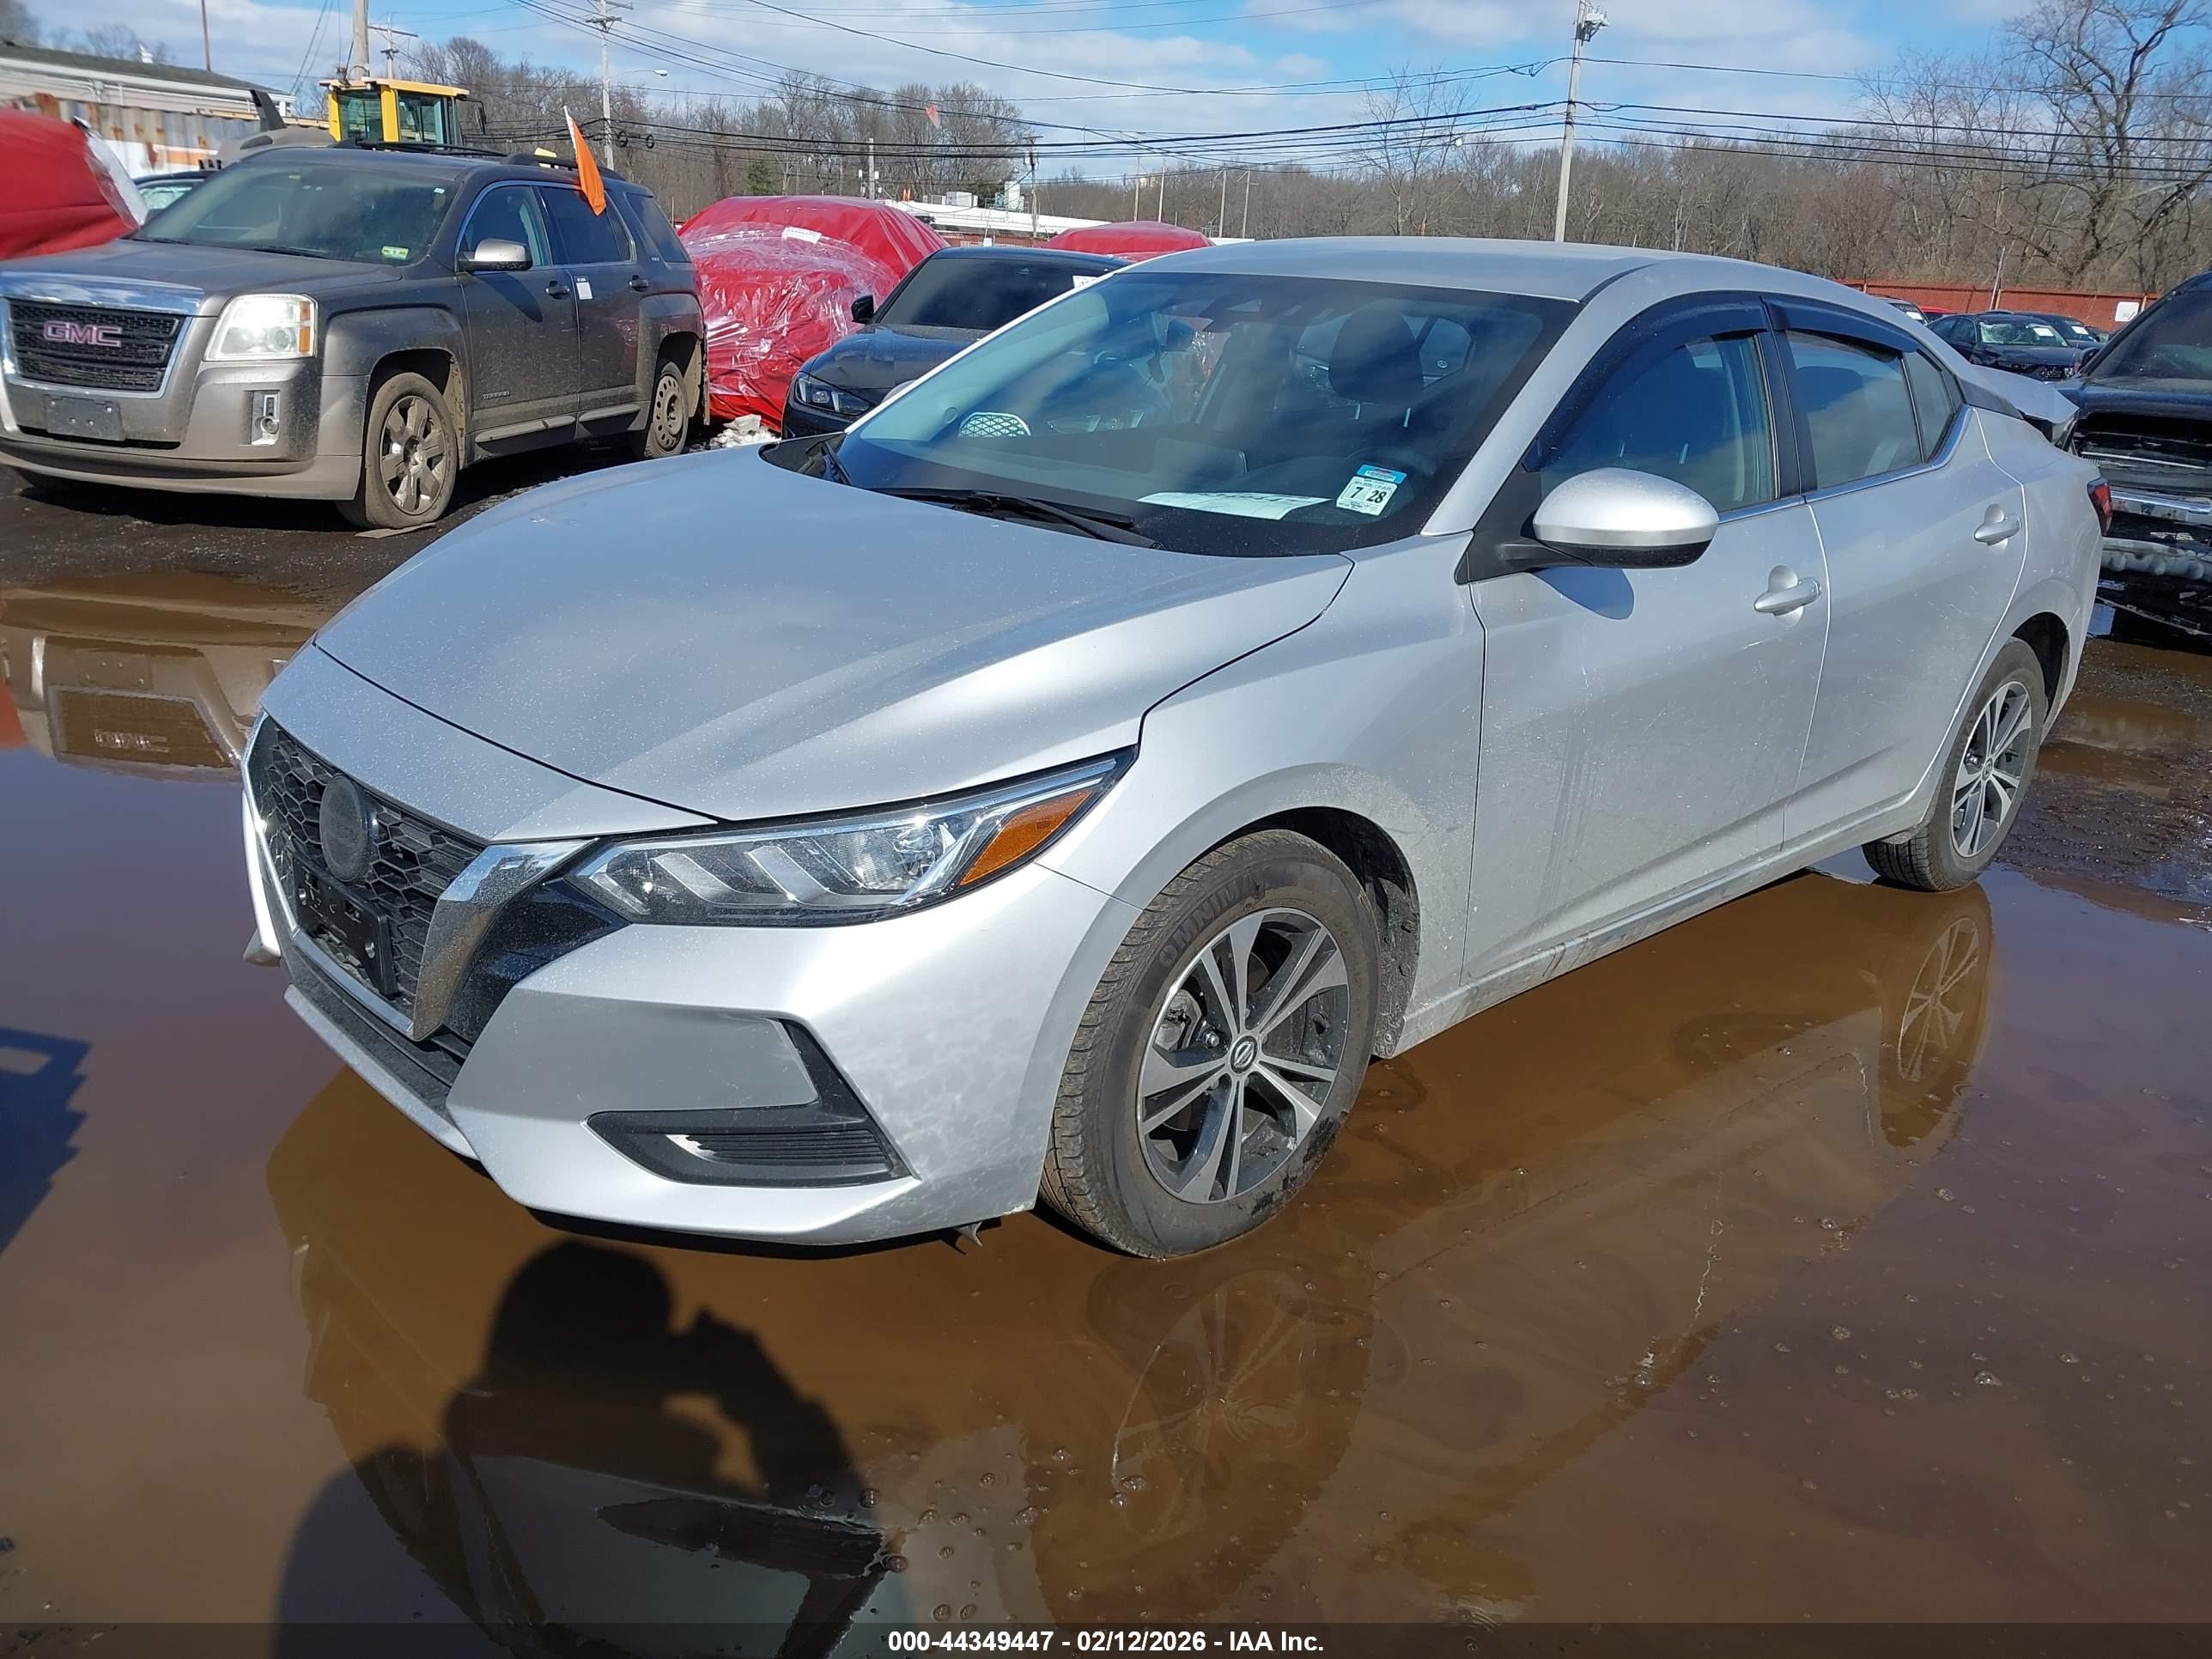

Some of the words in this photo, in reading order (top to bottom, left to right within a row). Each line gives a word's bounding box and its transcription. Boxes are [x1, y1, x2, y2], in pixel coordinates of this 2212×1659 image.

[43, 320, 122, 347] GMC
[1351, 486, 1364, 498] 7
[1366, 489, 1388, 503] 28
